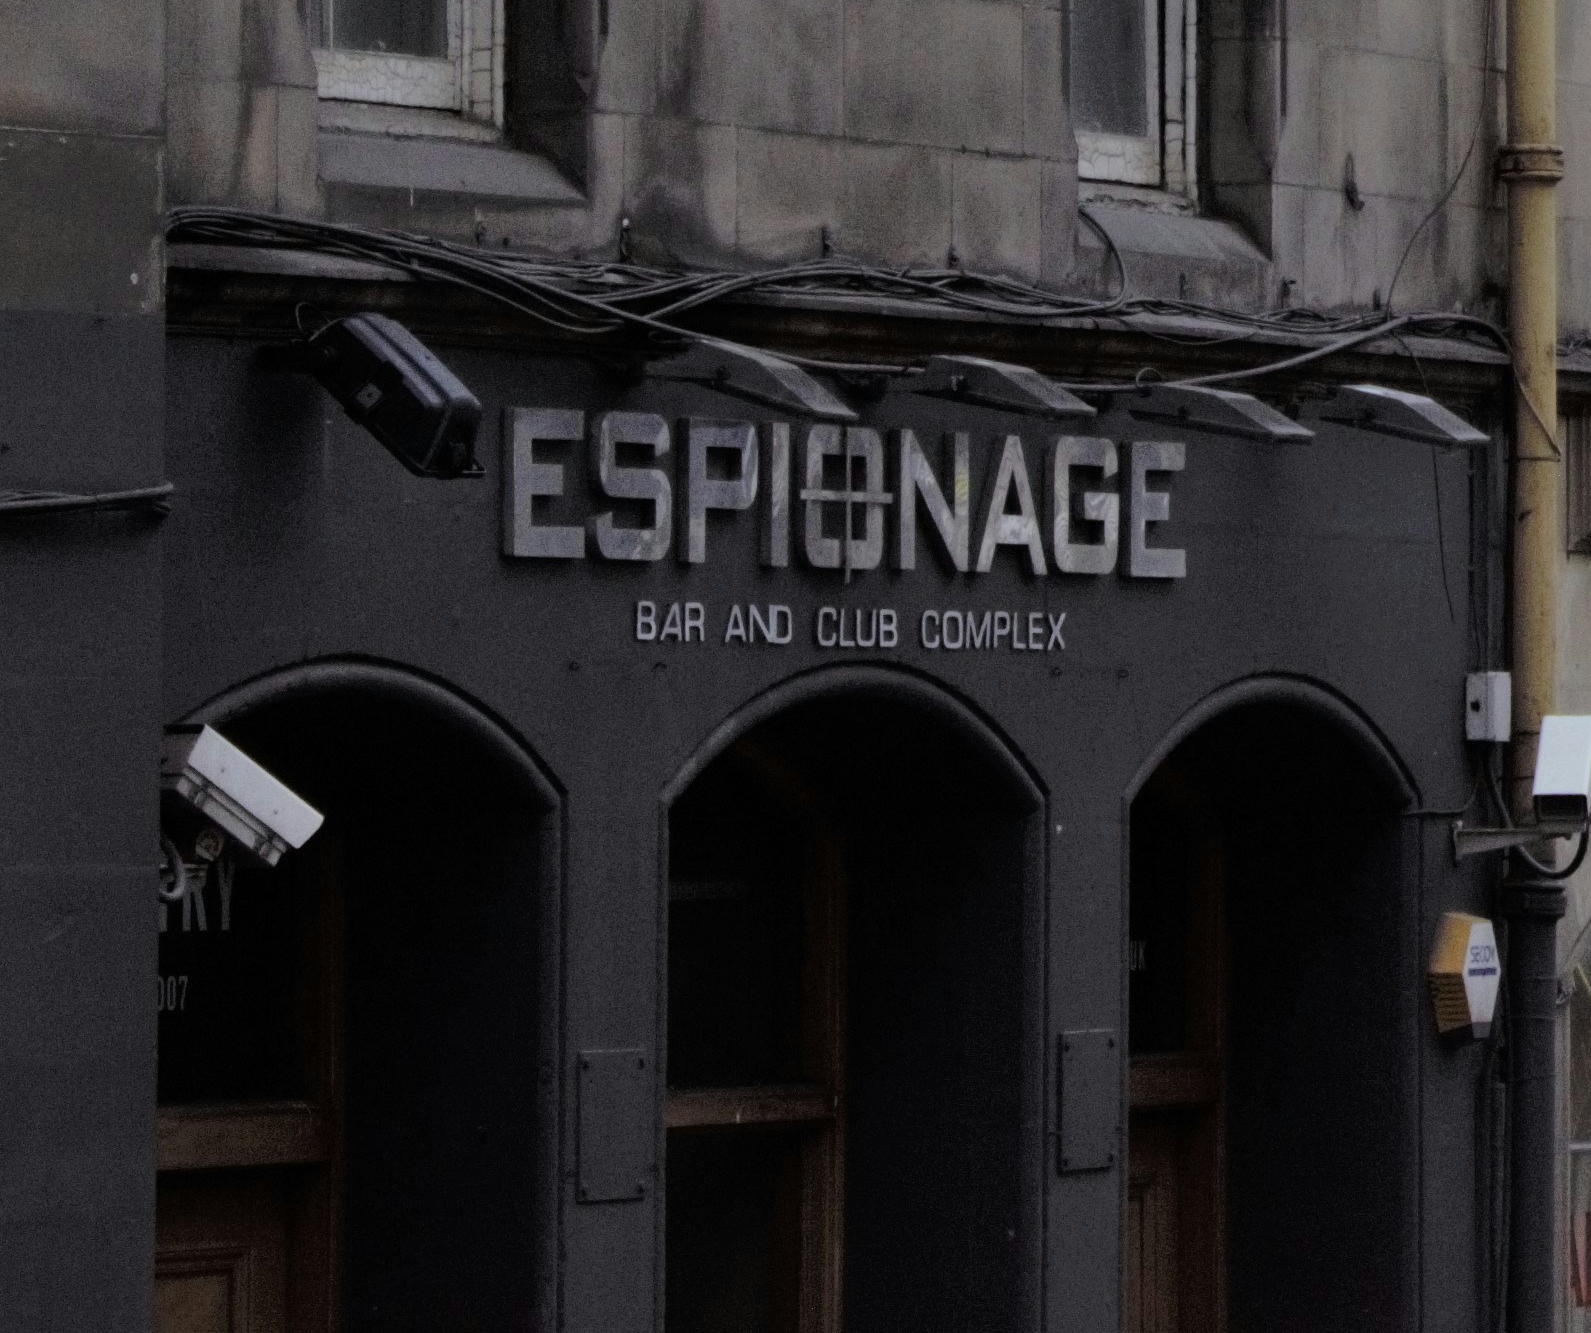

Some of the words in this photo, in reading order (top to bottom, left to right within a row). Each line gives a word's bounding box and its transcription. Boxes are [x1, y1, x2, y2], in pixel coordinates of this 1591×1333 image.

[504, 406, 1186, 581] ESPIONAGE
[636, 601, 705, 642] BAR
[724, 604, 793, 645] AND
[817, 607, 899, 648] CLUB
[921, 610, 1067, 650] COMPLEX
